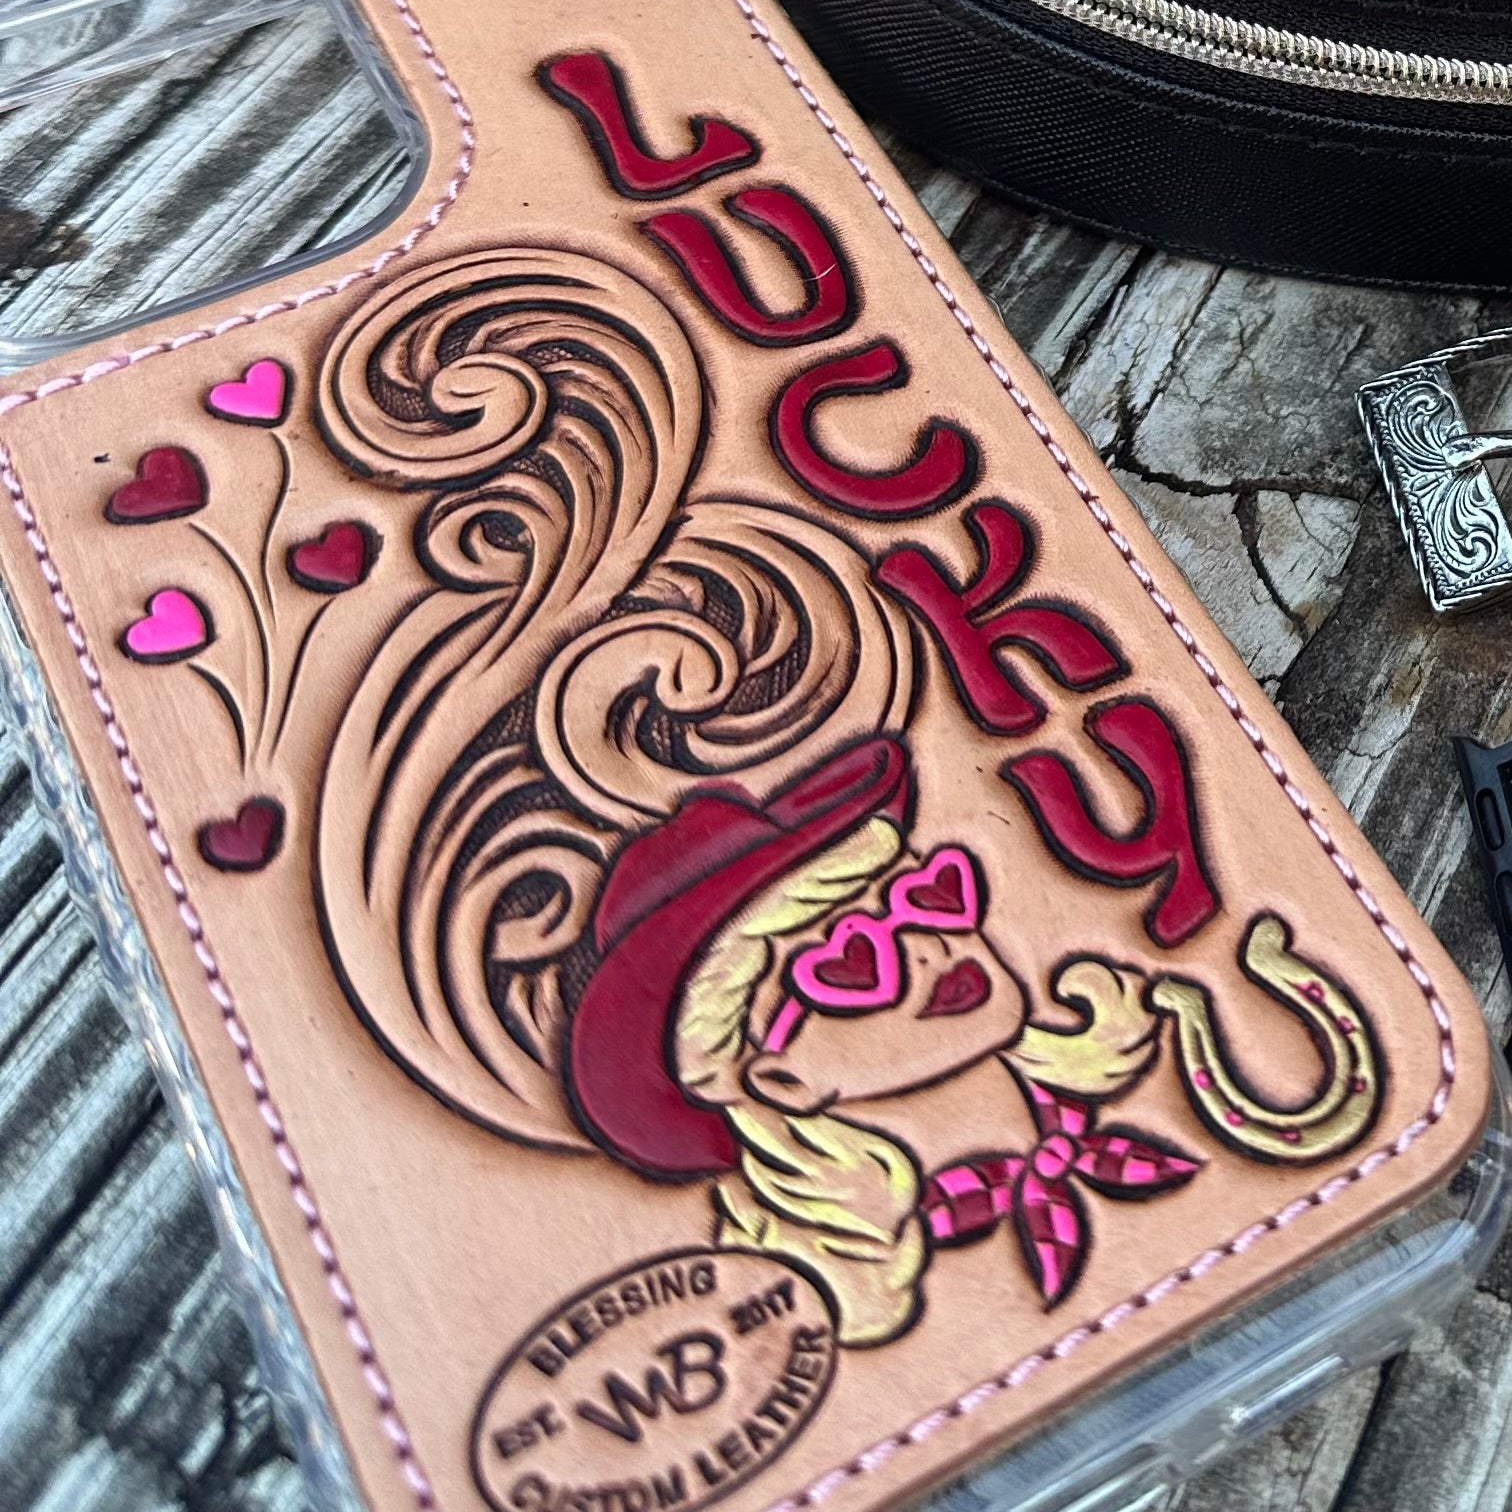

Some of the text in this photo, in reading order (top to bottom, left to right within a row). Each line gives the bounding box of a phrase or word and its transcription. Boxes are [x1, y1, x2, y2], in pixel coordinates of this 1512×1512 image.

[537, 50, 1220, 948] LUCKY
[526, 1259, 718, 1378] BLESSING
[728, 1277, 797, 1337] 2017
[693, 1325, 829, 1486] LEATHER
